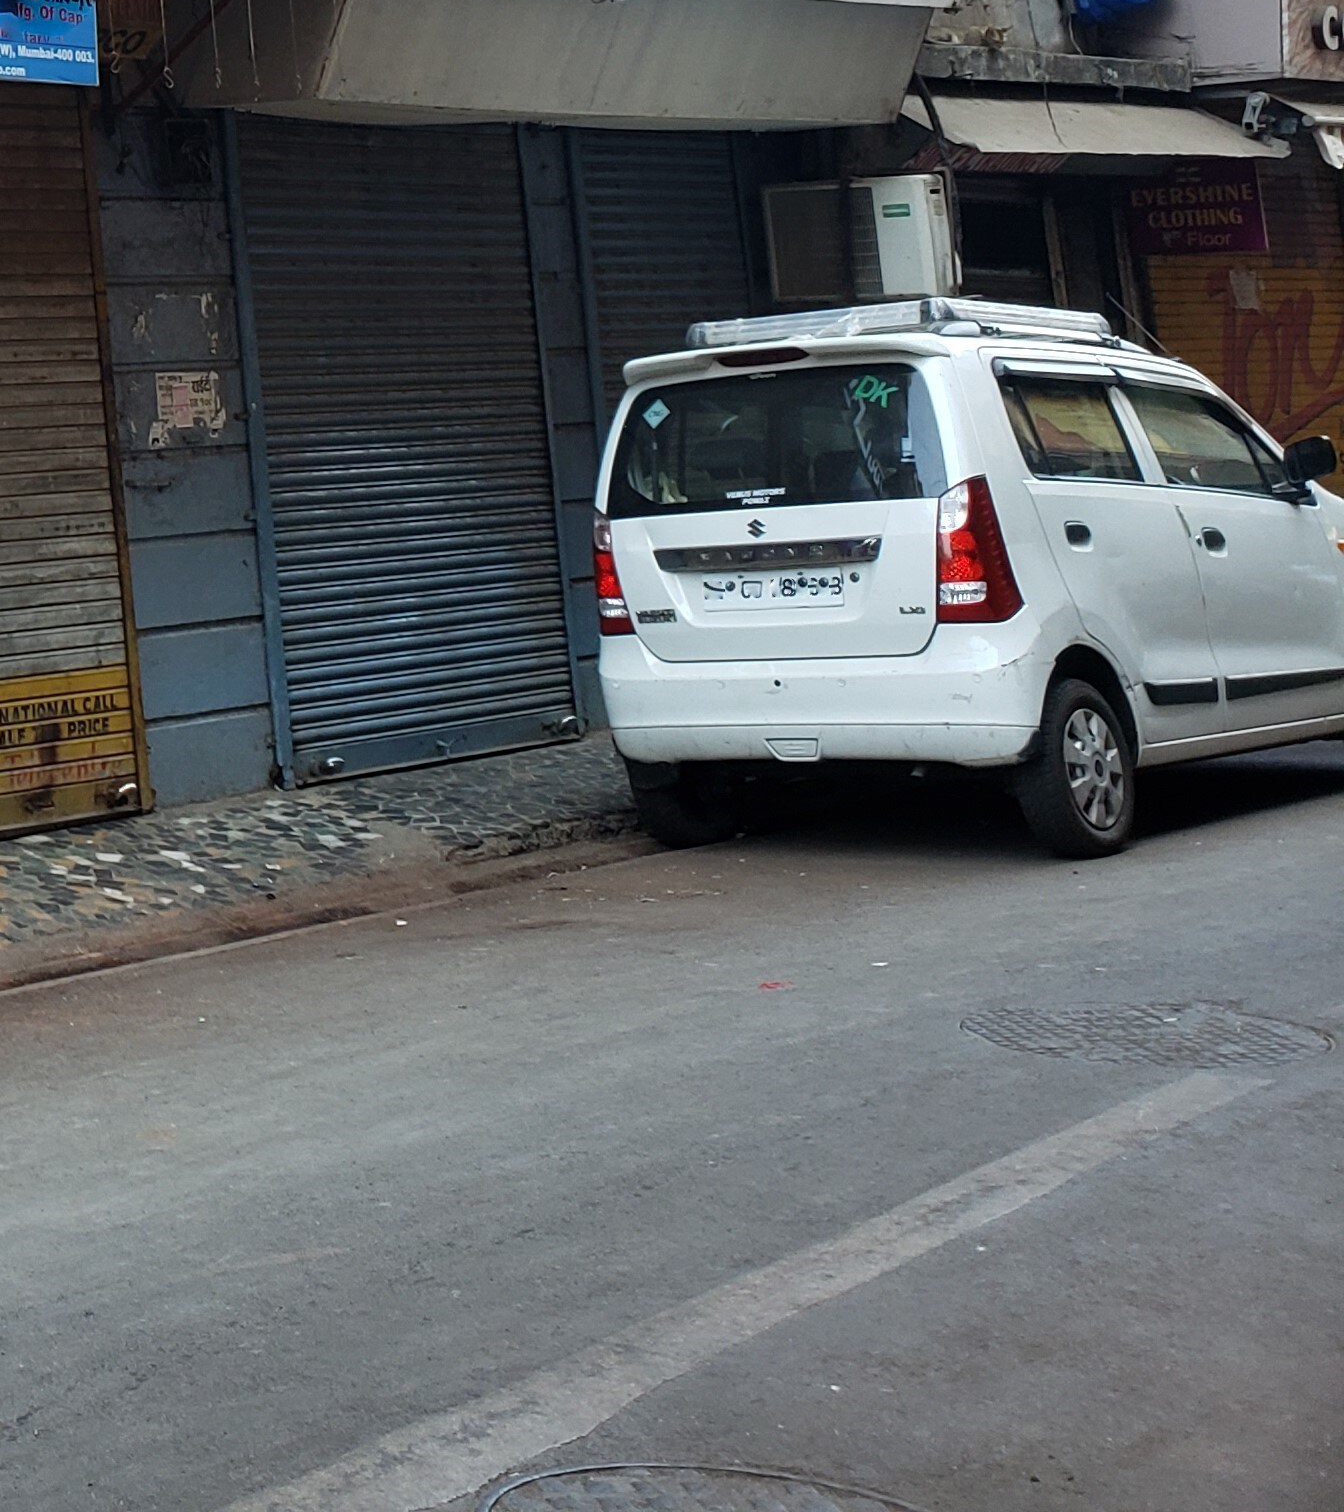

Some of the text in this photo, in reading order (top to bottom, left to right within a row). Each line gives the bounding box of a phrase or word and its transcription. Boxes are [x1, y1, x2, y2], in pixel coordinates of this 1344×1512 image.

[40, 5, 54, 18] Of
[1130, 183, 1254, 208] EVERSHINE
[1148, 207, 1244, 229] CLOTHING
[1187, 231, 1232, 247] Floor
[83, 694, 118, 711] CALL
[68, 717, 110, 737] PRICE
